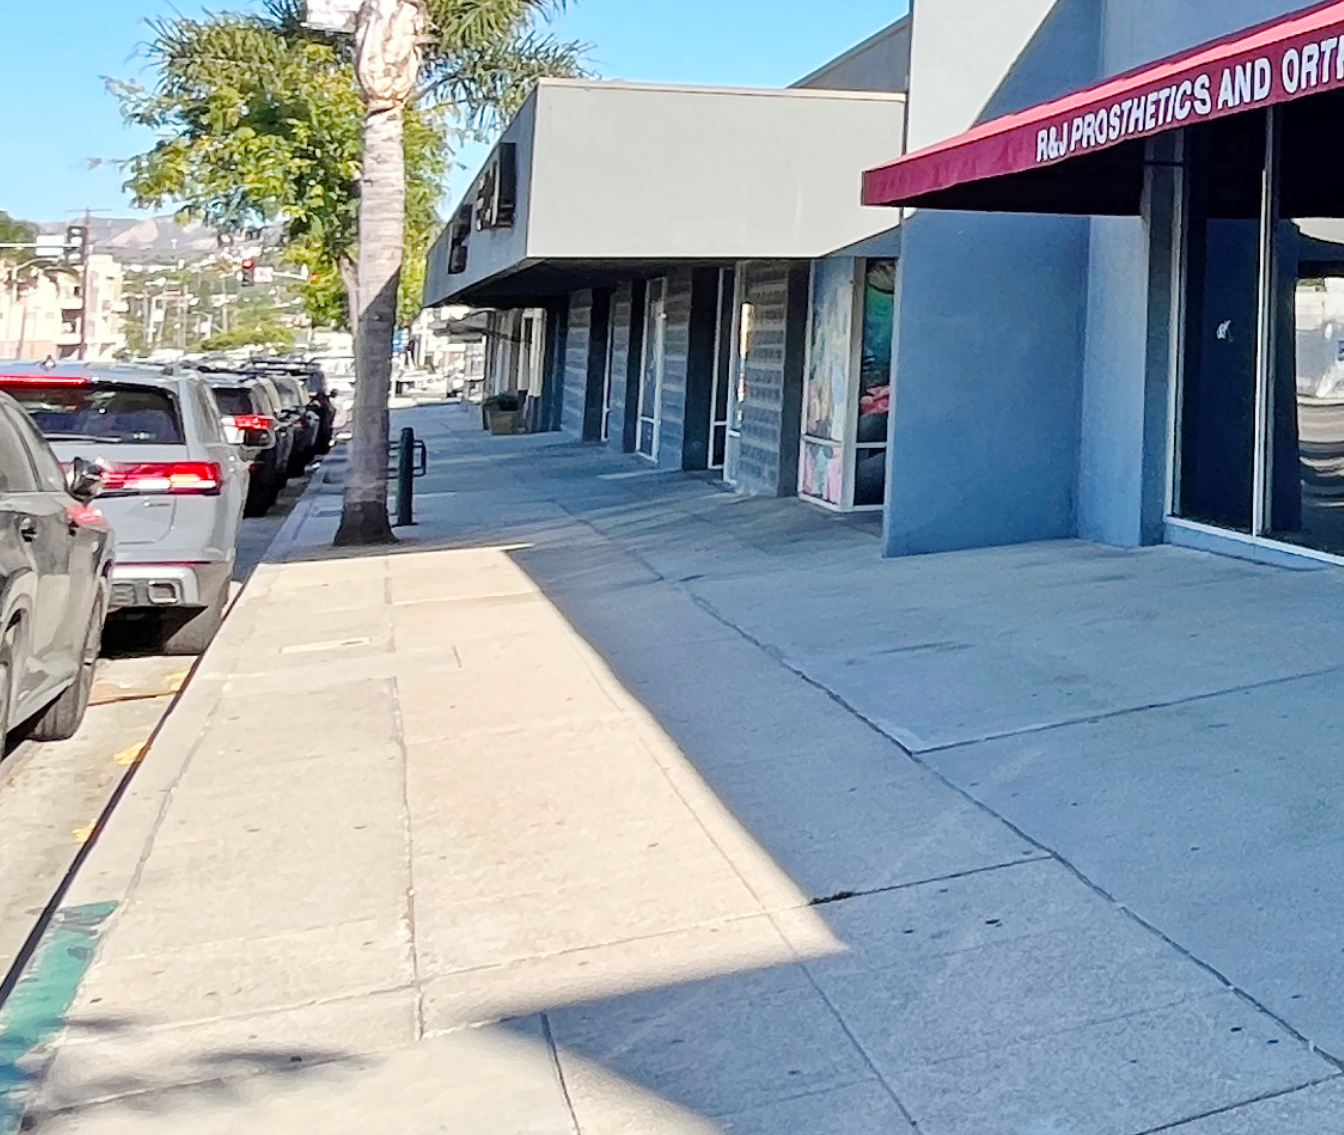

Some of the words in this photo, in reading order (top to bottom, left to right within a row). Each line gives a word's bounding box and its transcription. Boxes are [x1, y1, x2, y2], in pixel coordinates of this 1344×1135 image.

[1036, 122, 1068, 162] R&J
[1070, 74, 1212, 151] PROSTHETICS
[1217, 57, 1271, 110] AND
